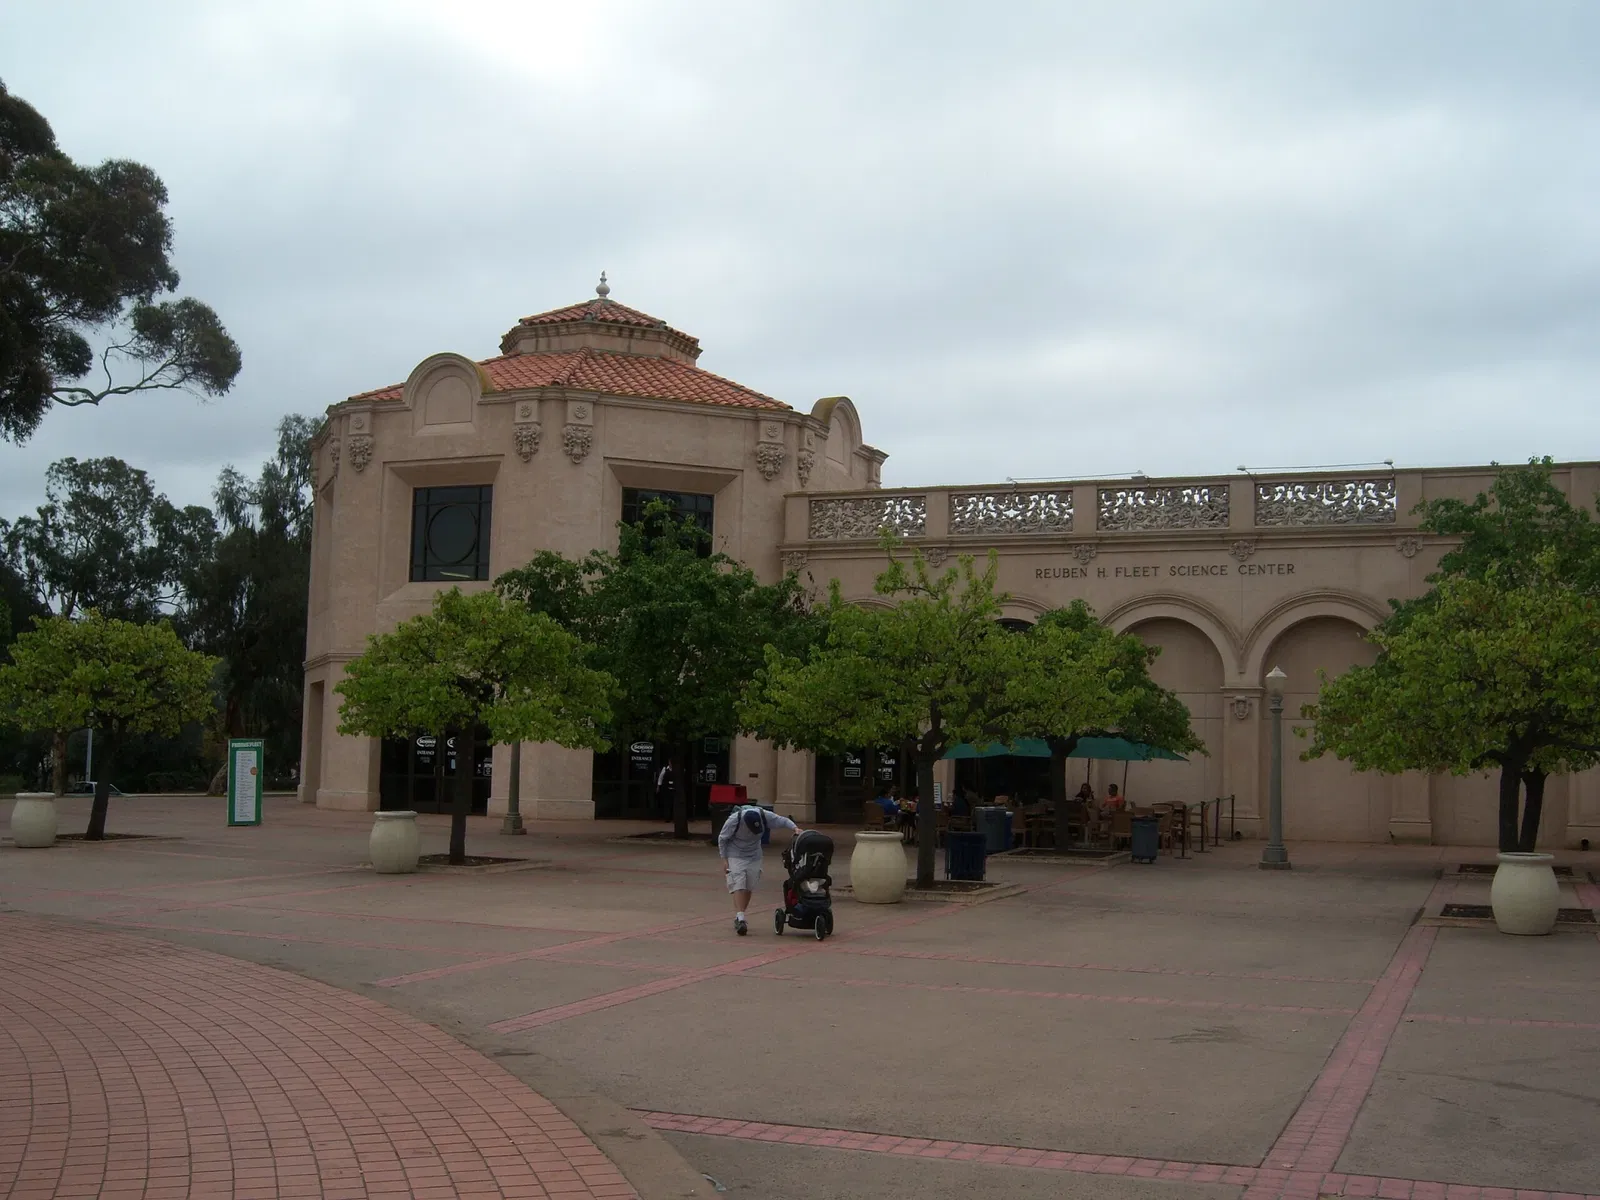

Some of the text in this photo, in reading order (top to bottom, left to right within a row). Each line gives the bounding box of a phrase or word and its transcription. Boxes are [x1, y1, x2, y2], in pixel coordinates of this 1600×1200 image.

[1035, 563, 1296, 579] REUBEN H. FLEET SCIENCE CENTER
